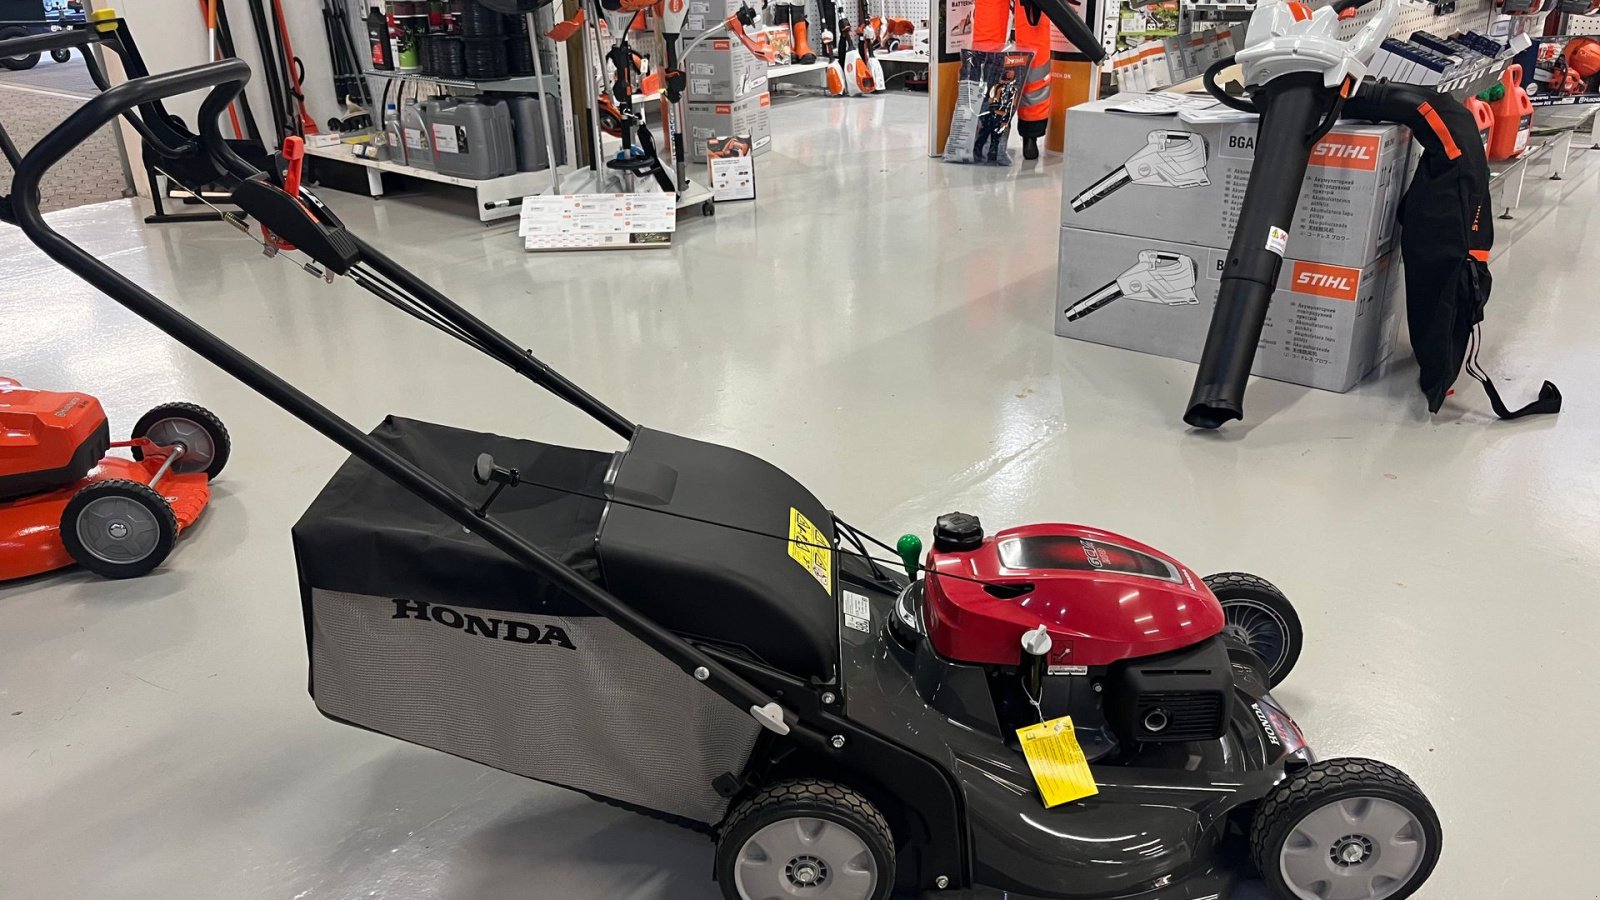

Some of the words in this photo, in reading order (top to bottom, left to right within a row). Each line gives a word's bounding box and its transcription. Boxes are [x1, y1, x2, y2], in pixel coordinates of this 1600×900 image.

[1229, 135, 1254, 149] BGA
[1314, 143, 1370, 160] STIHL
[1297, 271, 1351, 291] STIHL
[392, 599, 577, 650] HONDA
[1251, 703, 1280, 746] HONDA
